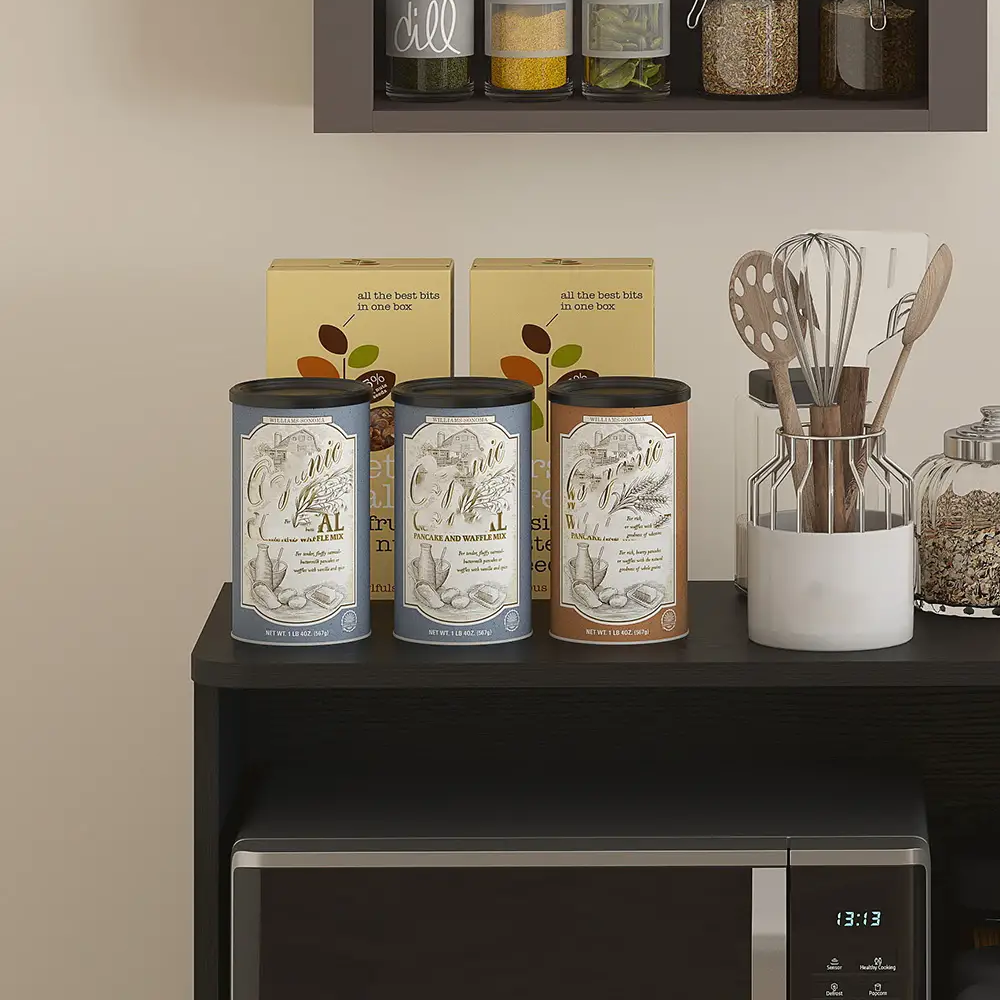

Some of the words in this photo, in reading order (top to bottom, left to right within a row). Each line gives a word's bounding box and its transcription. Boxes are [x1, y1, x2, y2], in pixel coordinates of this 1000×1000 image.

[357, 292, 371, 300] all
[374, 292, 392, 300] the
[394, 292, 418, 300] best
[420, 292, 440, 300] bits
[560, 291, 574, 299] all
[577, 291, 595, 299] the
[598, 291, 621, 299] best
[623, 291, 643, 299] bits
[357, 303, 368, 311] in
[393, 303, 412, 311] box
[560, 302, 571, 310] in
[596, 302, 615, 310] box
[413, 533, 443, 542] PANCAKE
[462, 534, 492, 542] WAFFLE
[837, 911, 881, 926] 13:13
